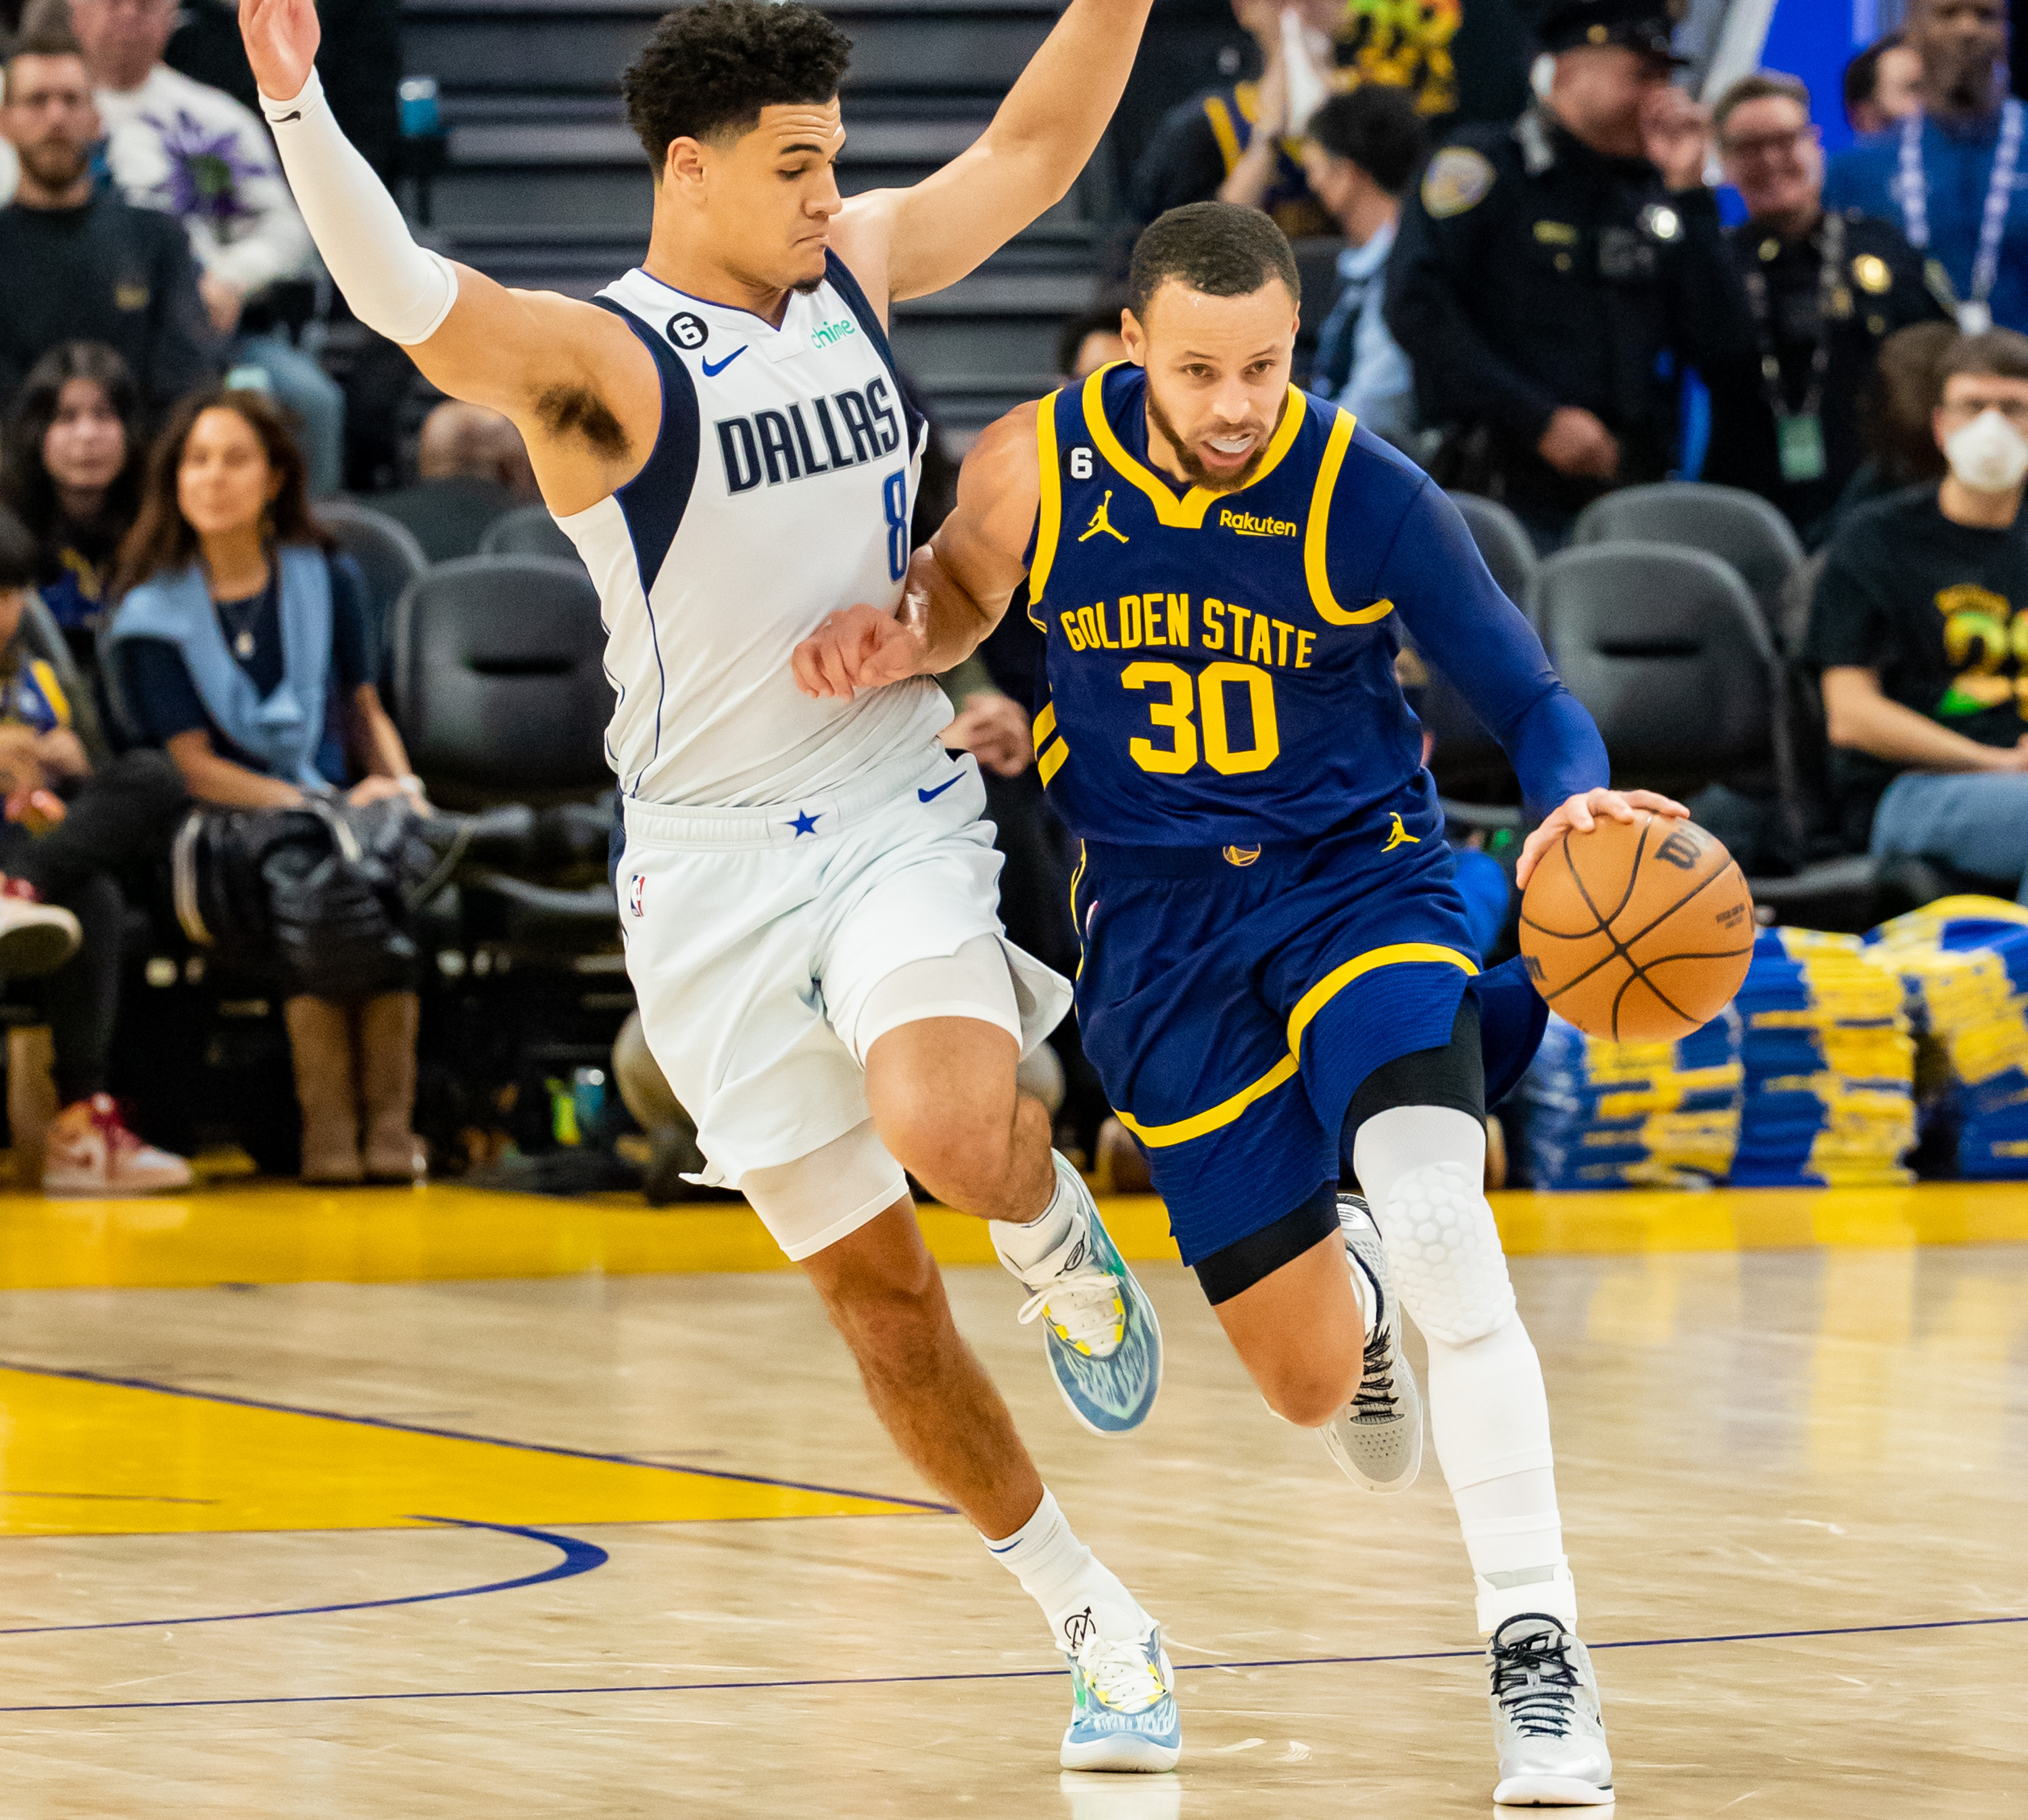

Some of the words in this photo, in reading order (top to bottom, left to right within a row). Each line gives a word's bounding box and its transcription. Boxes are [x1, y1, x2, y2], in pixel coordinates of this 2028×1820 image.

[673, 316, 702, 345] 6
[811, 320, 855, 349] chime
[713, 375, 900, 496] DALLAS
[1071, 448, 1092, 479] 6
[882, 466, 907, 585] 8
[1220, 510, 1297, 537] Rakuten
[1061, 593, 1189, 651] GOLDEN
[1203, 598, 1316, 668] STATE
[1121, 662, 1280, 775] 30
